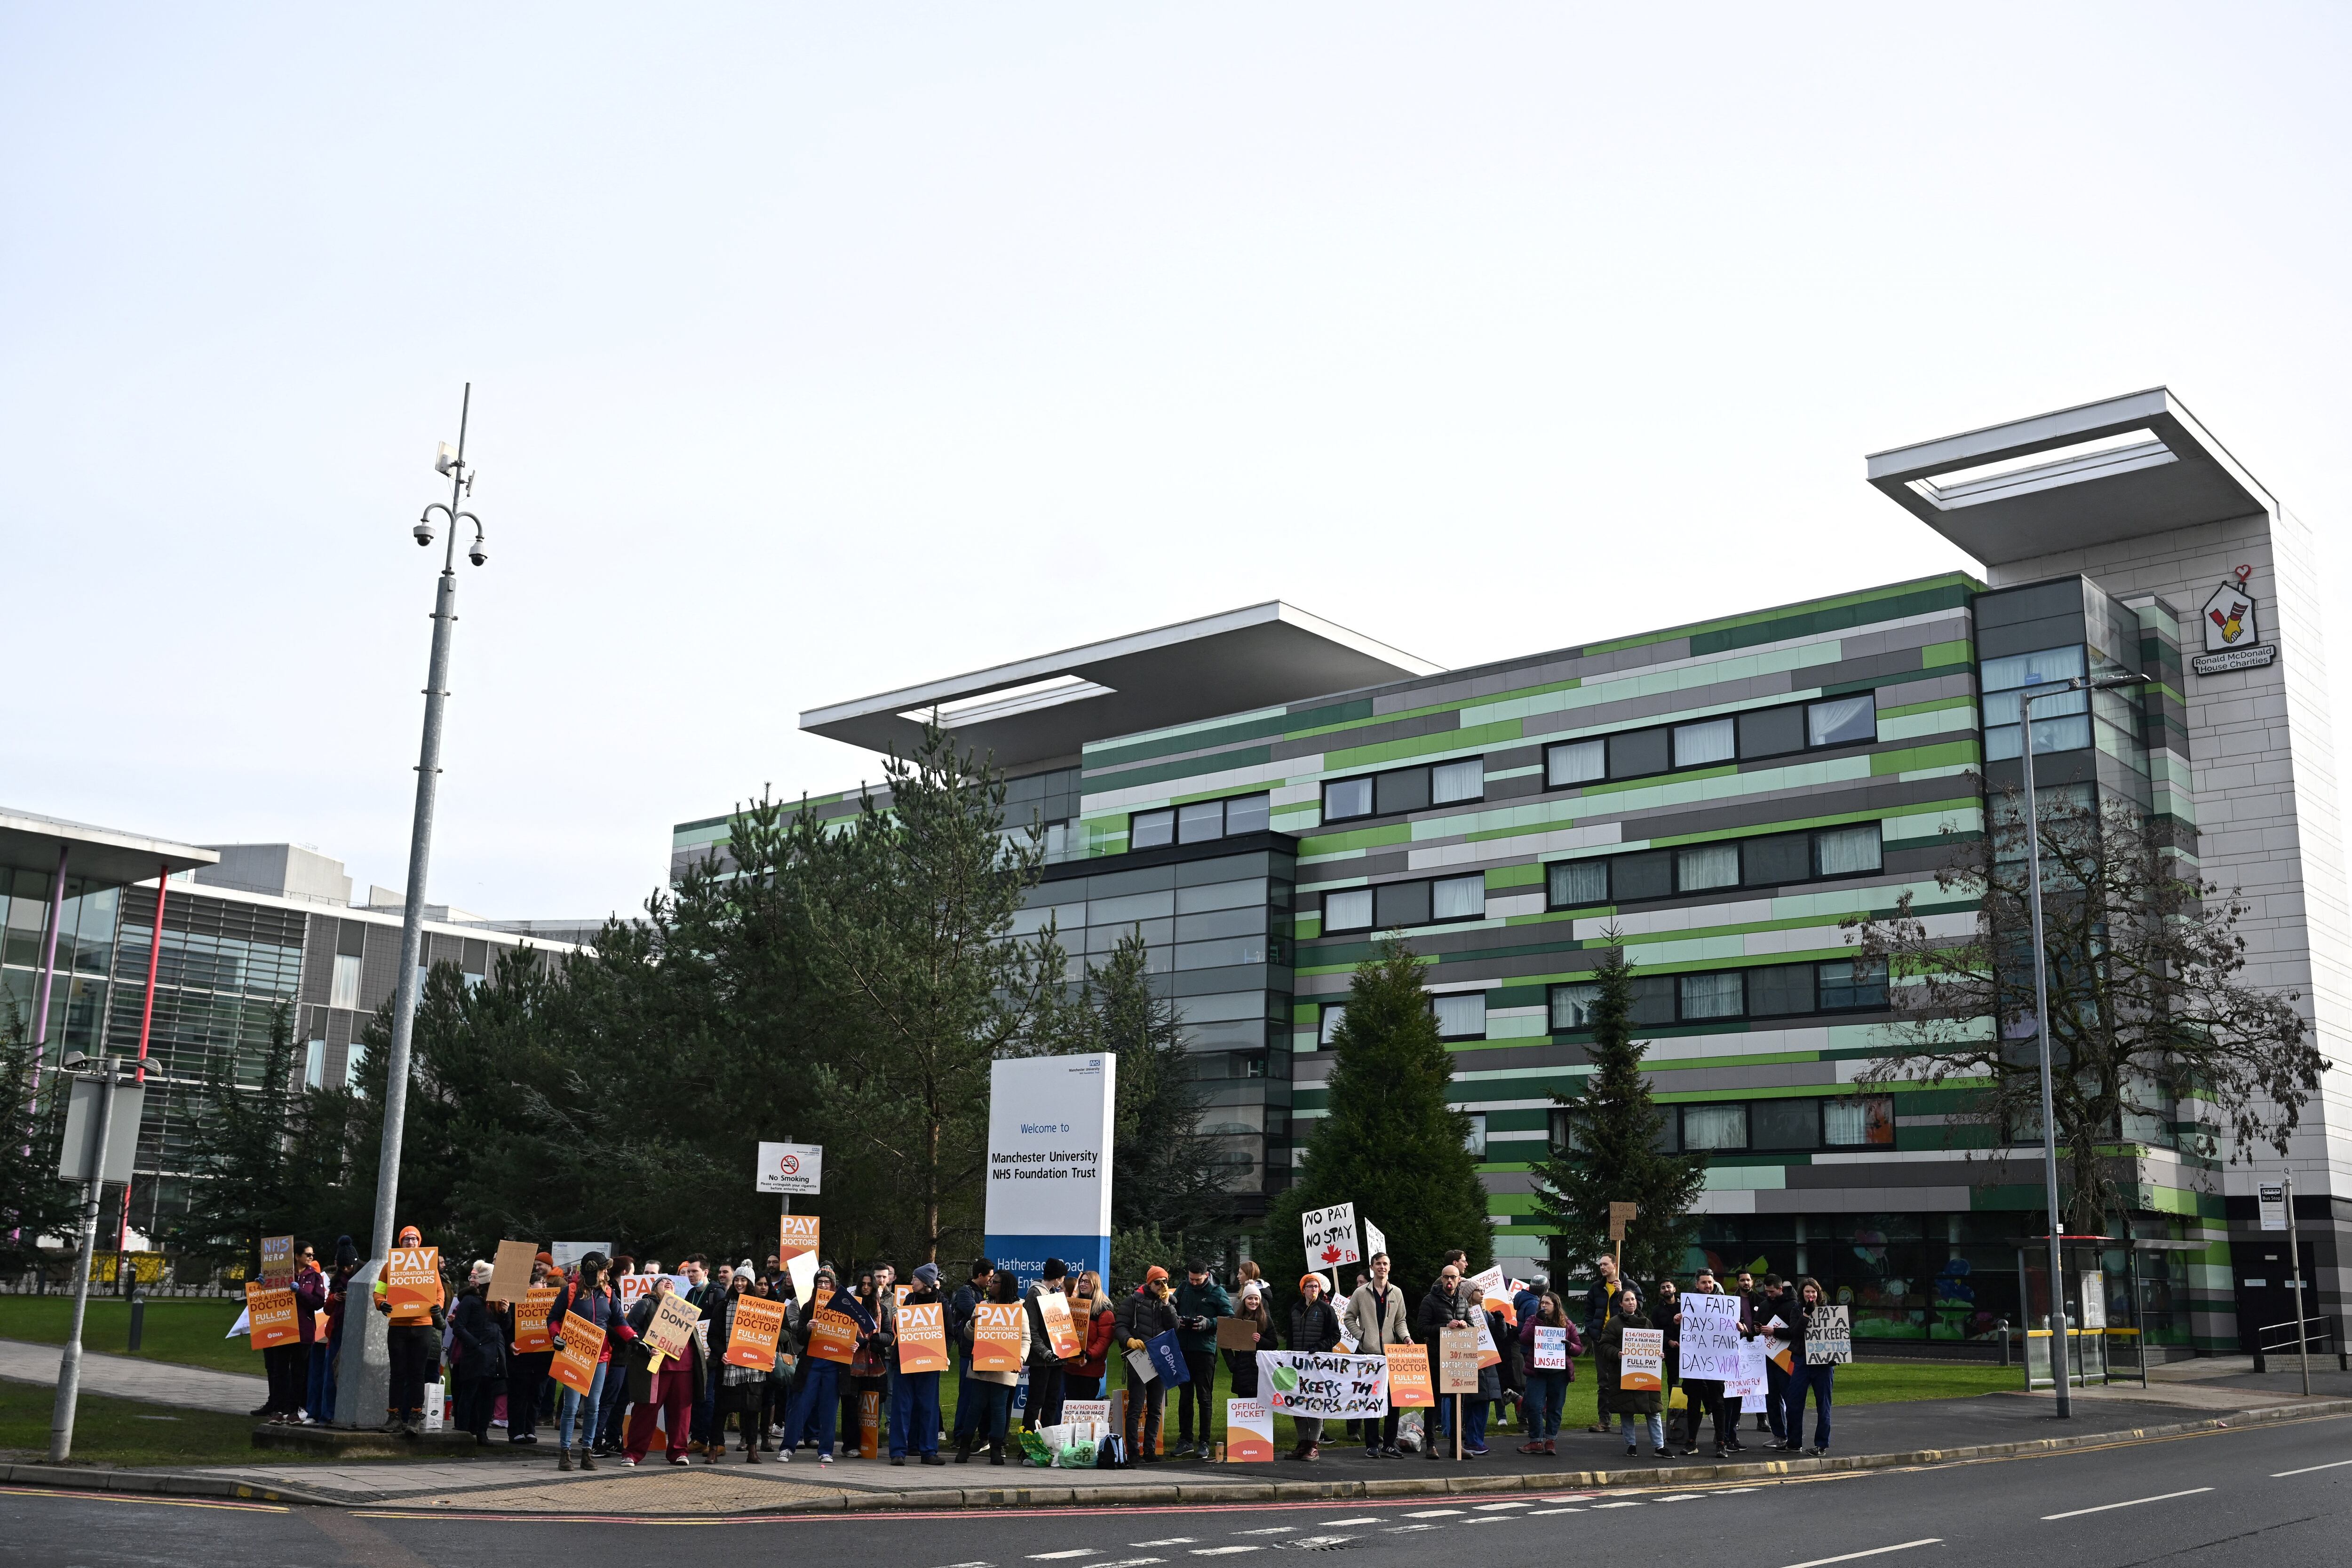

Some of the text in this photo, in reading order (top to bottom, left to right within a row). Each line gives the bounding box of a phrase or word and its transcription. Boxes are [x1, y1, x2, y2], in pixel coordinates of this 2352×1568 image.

[2195, 647, 2272, 665] Ronald McDonald
[2201, 657, 2268, 673] House Charities
[1021, 1123, 1069, 1134] Welcome to
[992, 1150, 1097, 1164] Manchester University
[781, 1175, 809, 1184] Smoking
[993, 1167, 1096, 1179] NHS Foundation Trust
[1305, 1205, 1348, 1227] NO PAY
[783, 1217, 818, 1235] PAY
[1306, 1233, 1320, 1248] NO
[1324, 1224, 1352, 1244] STAY
[264, 1238, 289, 1253] NHS
[264, 1253, 284, 1262] HERO
[390, 1250, 435, 1271] PAY
[1346, 1250, 1357, 1262] Eh
[997, 1258, 1046, 1274] Hathersag
[264, 1276, 294, 1288] ZERO
[390, 1276, 435, 1285] DOCTORS
[270, 1291, 293, 1299] JUNIOR
[250, 1297, 293, 1312] DOCTOR
[665, 1296, 698, 1321] CLAPS
[741, 1299, 775, 1311] £14/HOUR
[1683, 1296, 1735, 1316] A FAIR
[255, 1309, 291, 1321] FULL PAY
[756, 1315, 780, 1324] JUNIOR
[816, 1311, 855, 1327] DOCTOR
[898, 1306, 939, 1328] PAY
[977, 1307, 1020, 1325] PAY
[1818, 1307, 1839, 1318] PAY
[566, 1315, 597, 1336] £14/HOUR
[736, 1316, 778, 1333] DOCTOR
[817, 1323, 851, 1336] FULL PAY
[1683, 1317, 1714, 1332] DAYS
[1807, 1317, 1846, 1328] CUT A
[564, 1327, 599, 1350] FOR JUNIOR
[578, 1329, 588, 1337] FAIR
[738, 1329, 772, 1342] FULL PAY
[900, 1330, 943, 1342] DOCTORS
[1441, 1330, 1455, 1338] MPs
[1805, 1328, 1850, 1340] DAY KEEPS
[561, 1332, 597, 1359] DOCTOR
[649, 1330, 683, 1358] THE BILLS
[1698, 1335, 1707, 1349] A
[1713, 1335, 1739, 1350] FAIR
[1624, 1348, 1661, 1356] DOCTOR
[1808, 1352, 1848, 1363] AWAY
[579, 1355, 592, 1366] PAY
[1165, 1353, 1176, 1376] BMA
[1292, 1355, 1386, 1378] UNFAIR PAY
[1535, 1357, 1565, 1367] UNSAFE
[1682, 1353, 1739, 1378] DAYS WORK
[1299, 1376, 1380, 1398] KEEPS THE
[1751, 1377, 1761, 1386] FLY
[1272, 1393, 1383, 1413] DOCTORS AWAY
